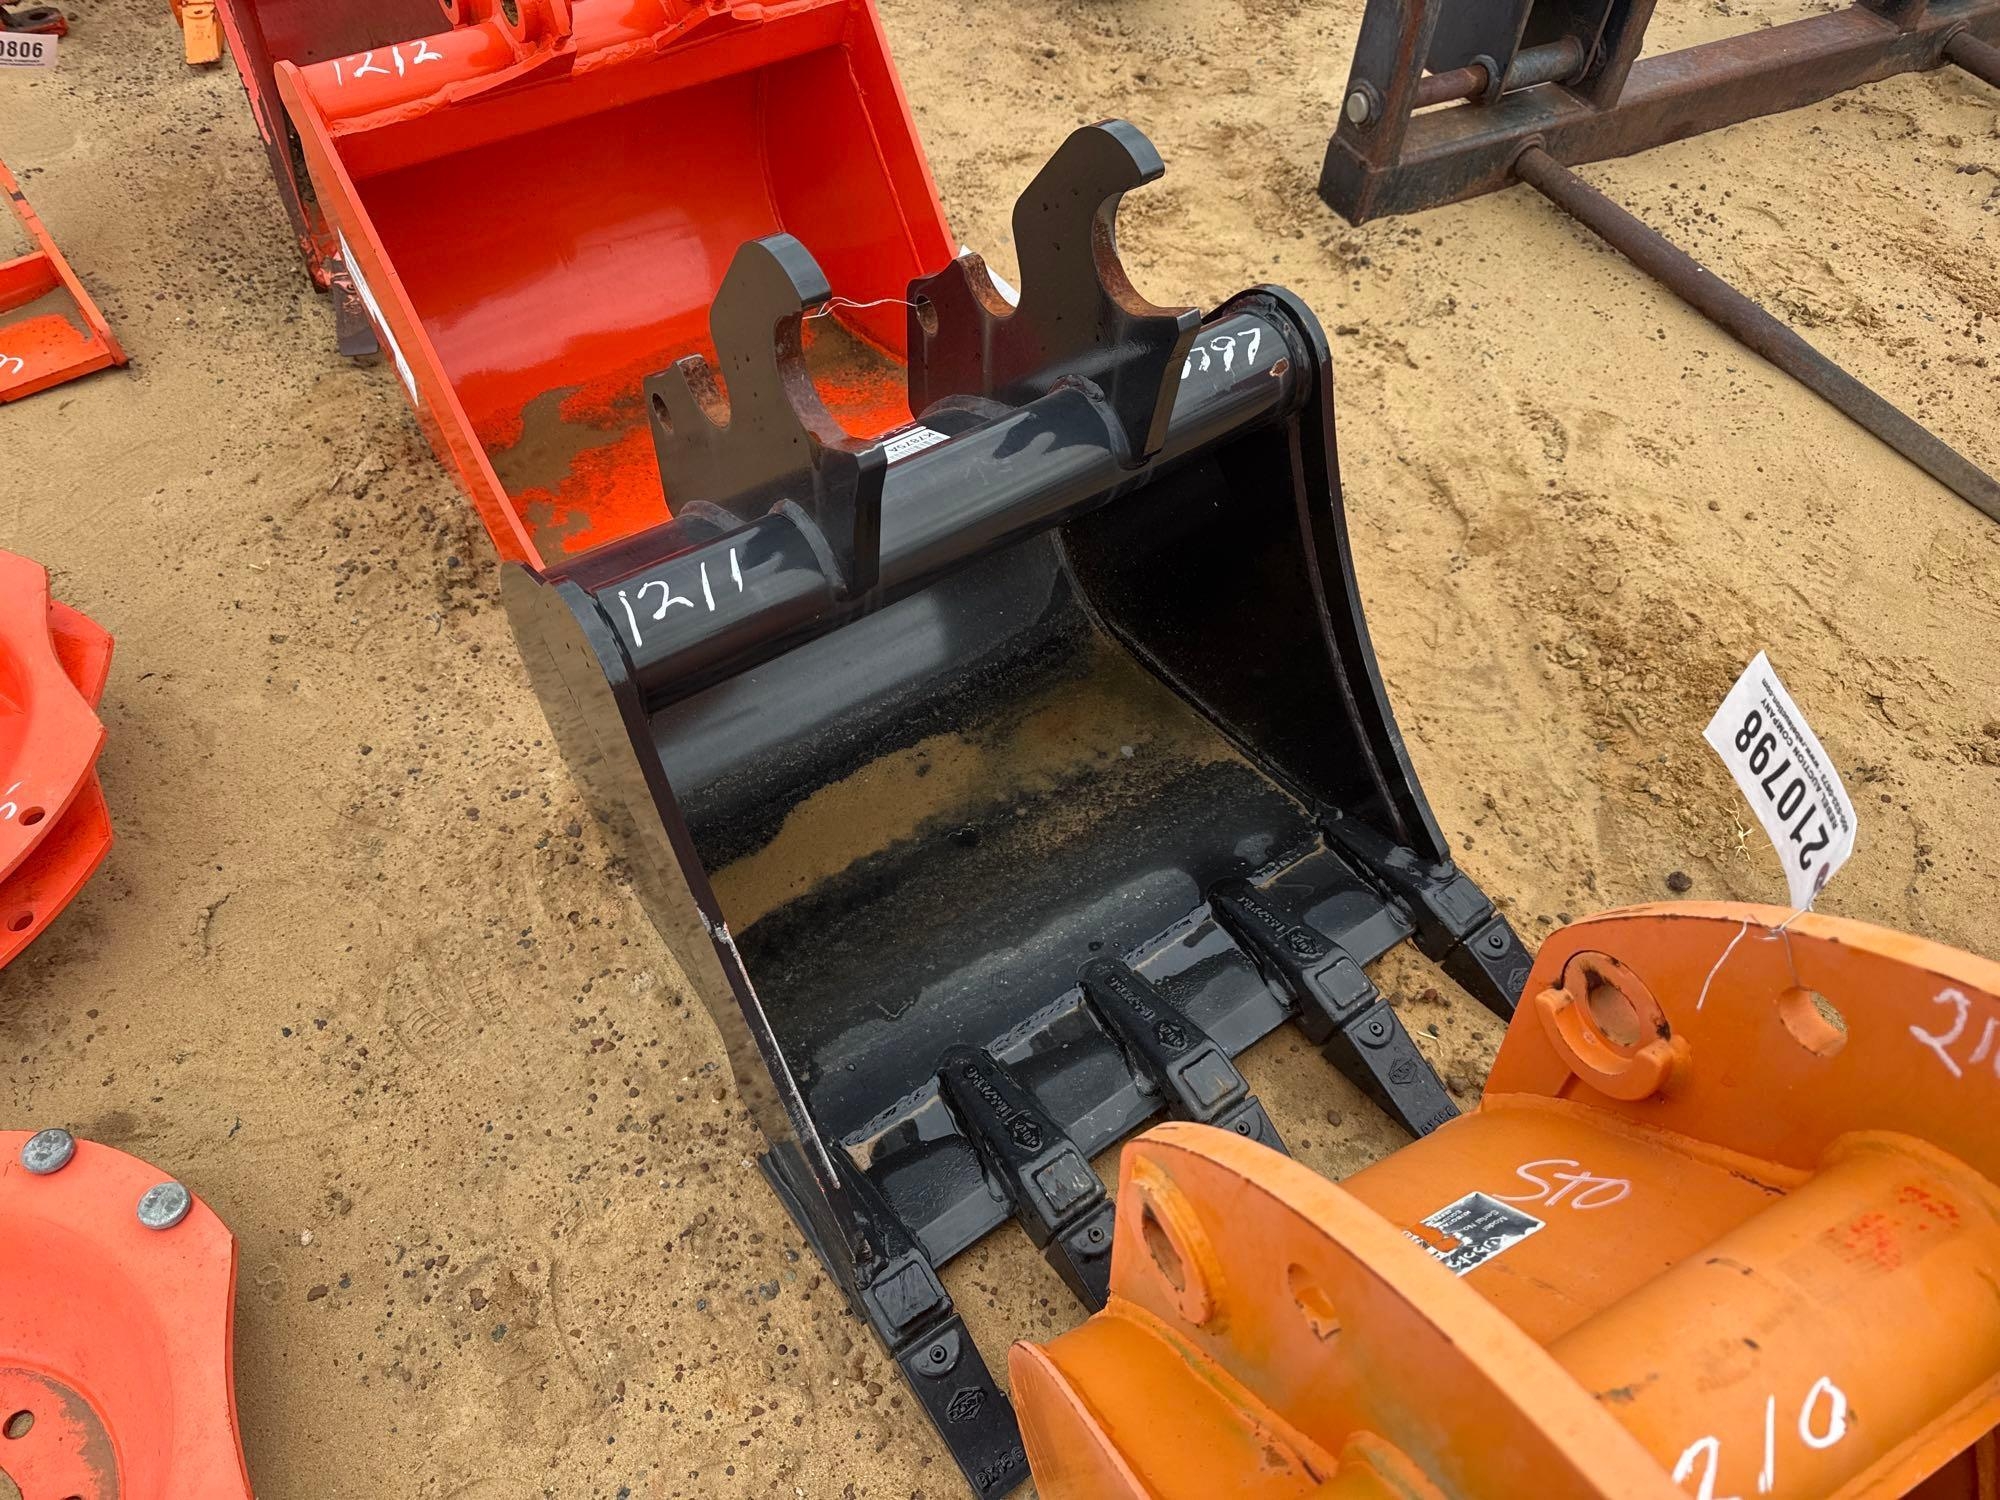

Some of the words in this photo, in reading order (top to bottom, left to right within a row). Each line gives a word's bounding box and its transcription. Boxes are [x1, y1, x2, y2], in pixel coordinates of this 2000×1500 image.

[332, 40, 443, 87] 1212
[1181, 327, 1261, 380] 797
[618, 547, 743, 648] 1211
[1760, 698, 1794, 747] COMPANY
[1734, 710, 1830, 872] 210798
[1792, 746, 1822, 793] AUCTION
[1821, 792, 1838, 831] REBEL
[1909, 987, 2000, 1079] 21
